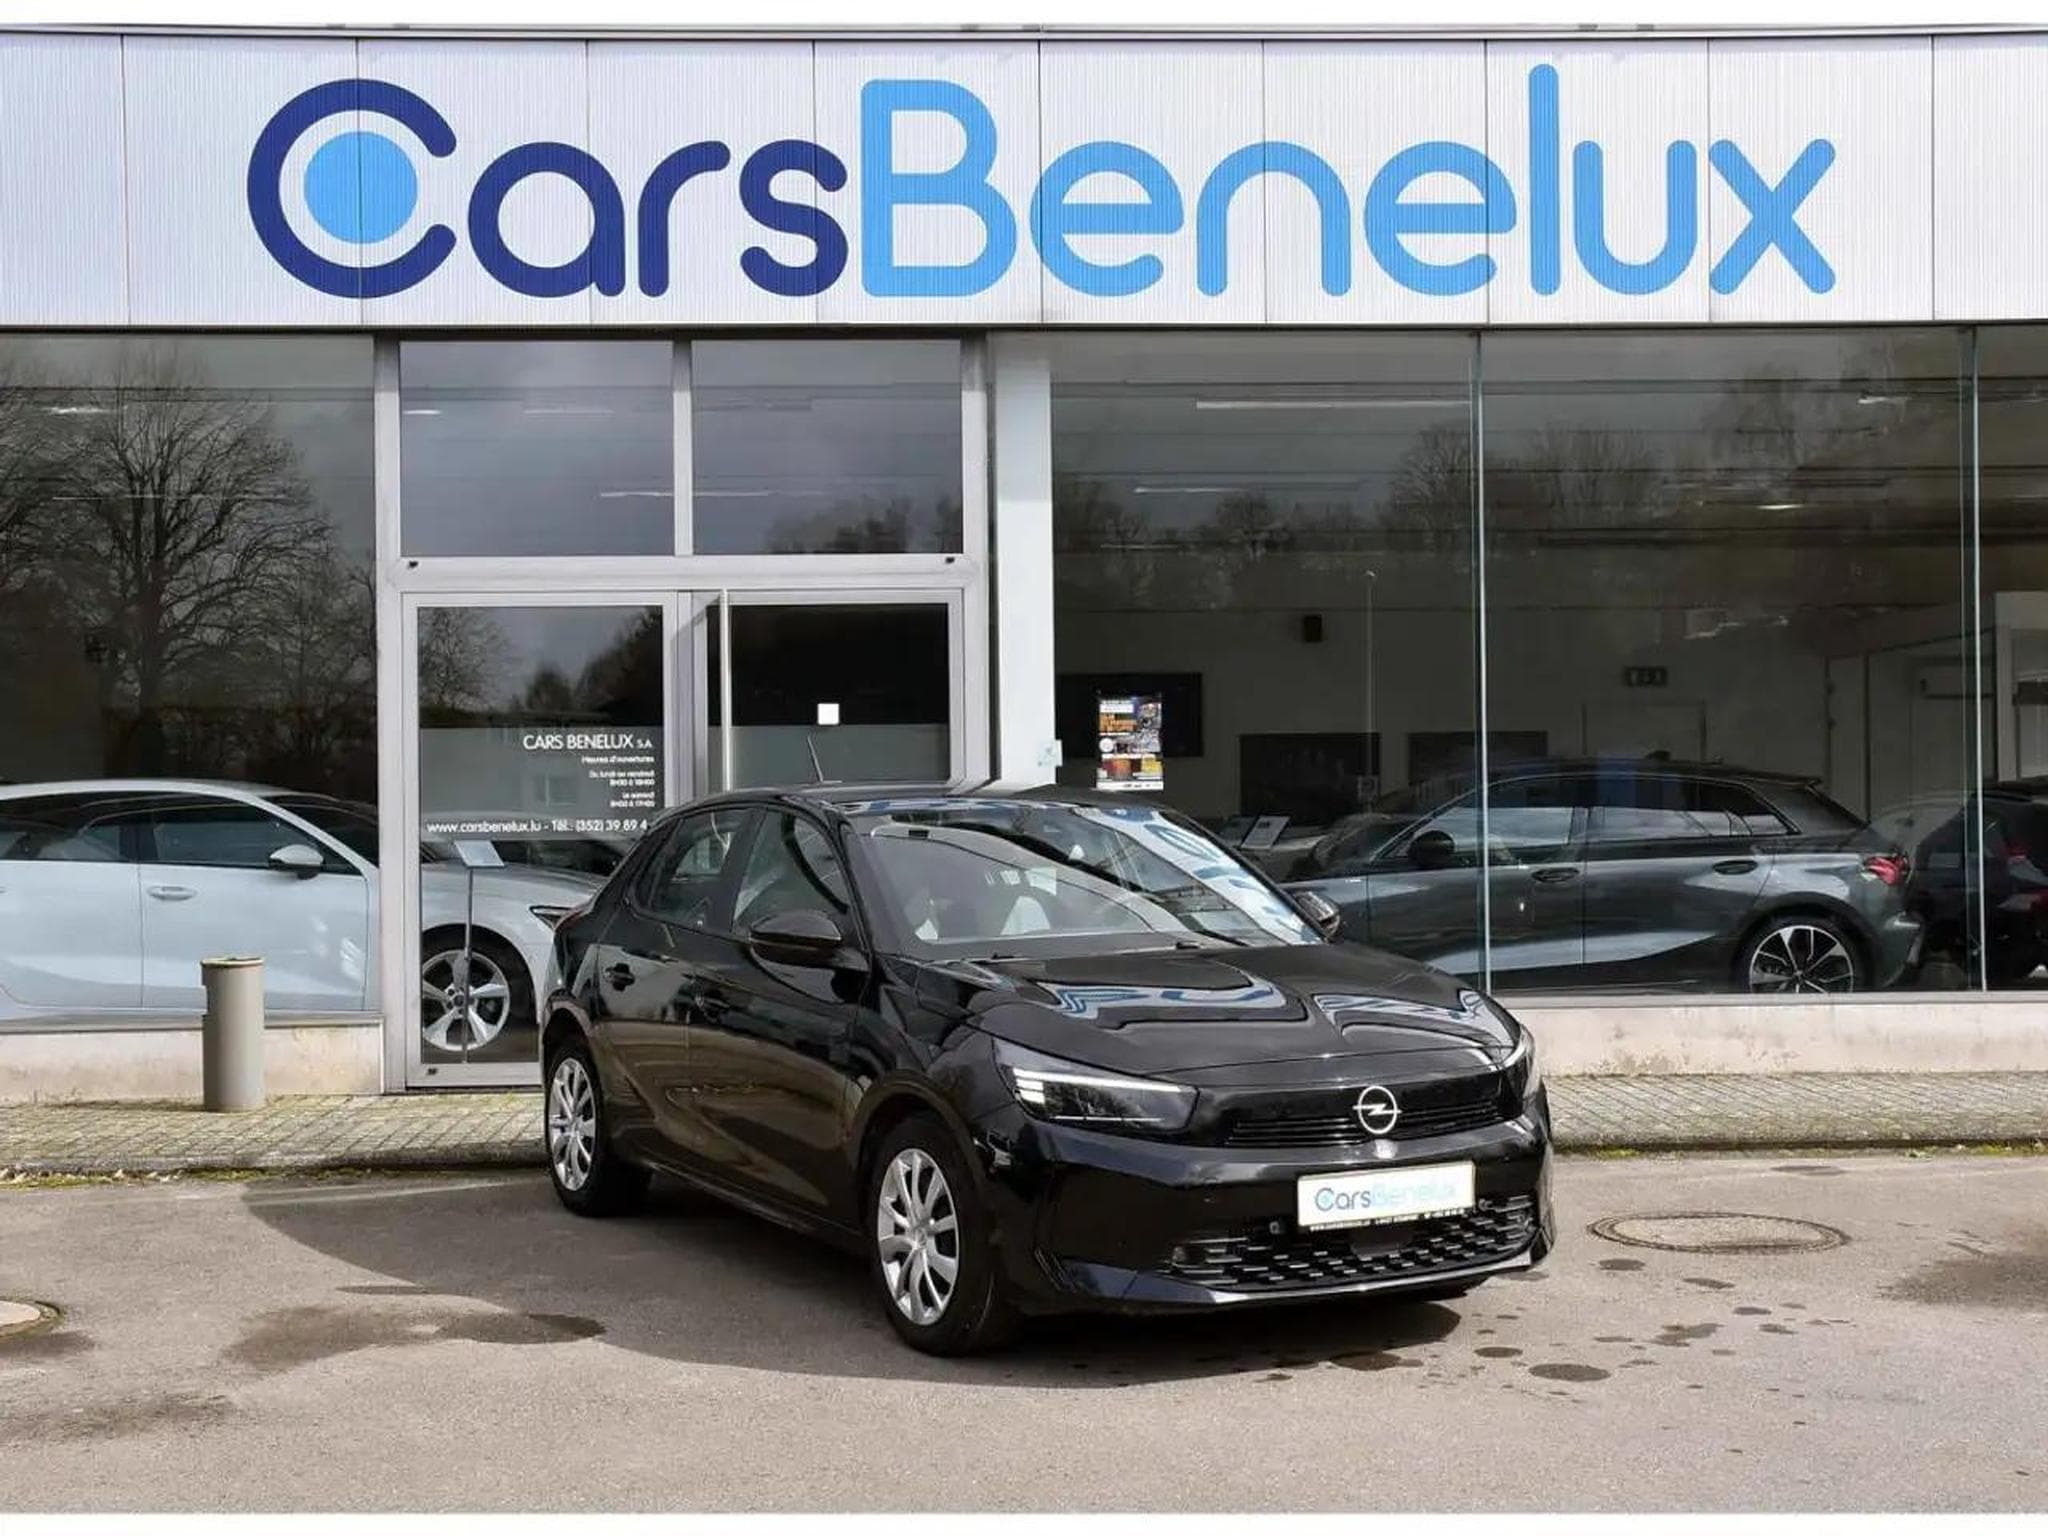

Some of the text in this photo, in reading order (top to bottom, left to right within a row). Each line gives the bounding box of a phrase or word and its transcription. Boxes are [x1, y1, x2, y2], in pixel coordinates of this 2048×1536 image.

[247, 64, 1836, 299] CarsBenelux
[523, 734, 564, 750] CARS
[566, 734, 634, 749] BENELUX
[427, 820, 541, 833] www.carsbenelux.lu
[575, 819, 604, 832] (352)
[605, 819, 620, 831] 39
